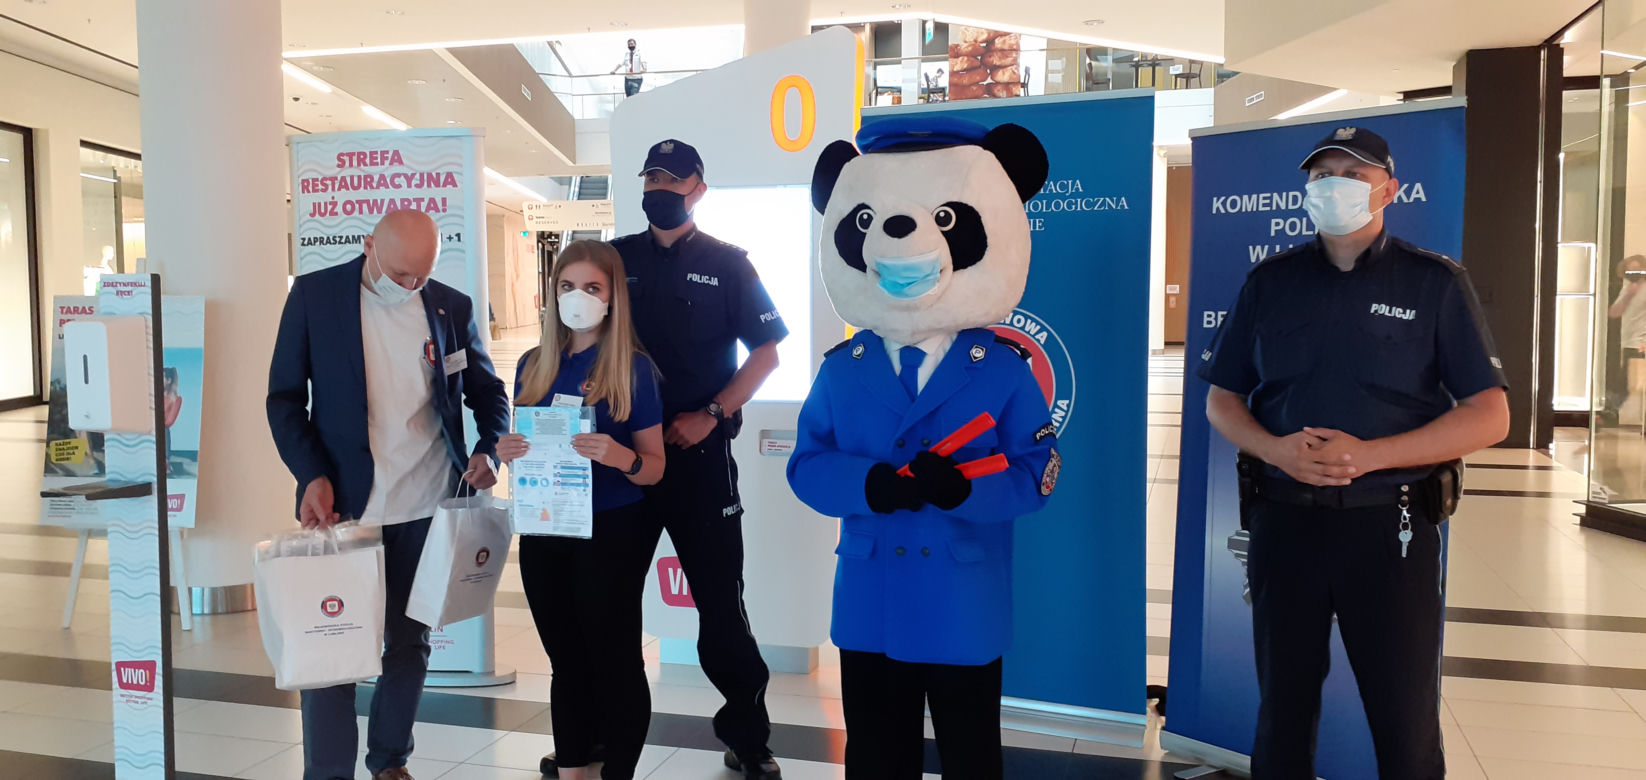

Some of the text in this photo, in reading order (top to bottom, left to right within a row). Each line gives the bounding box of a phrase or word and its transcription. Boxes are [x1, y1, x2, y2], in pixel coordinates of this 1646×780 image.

[769, 74, 816, 152] 0
[336, 149, 404, 169] STREFA
[301, 171, 458, 194] RESTAURACYJNA
[309, 196, 339, 218] JUŻ
[446, 233, 462, 243] +1
[686, 273, 719, 287] POLICJA
[59, 305, 94, 315] TARAS
[1370, 303, 1416, 321] POLICJA
[120, 667, 150, 686] VIVO!
